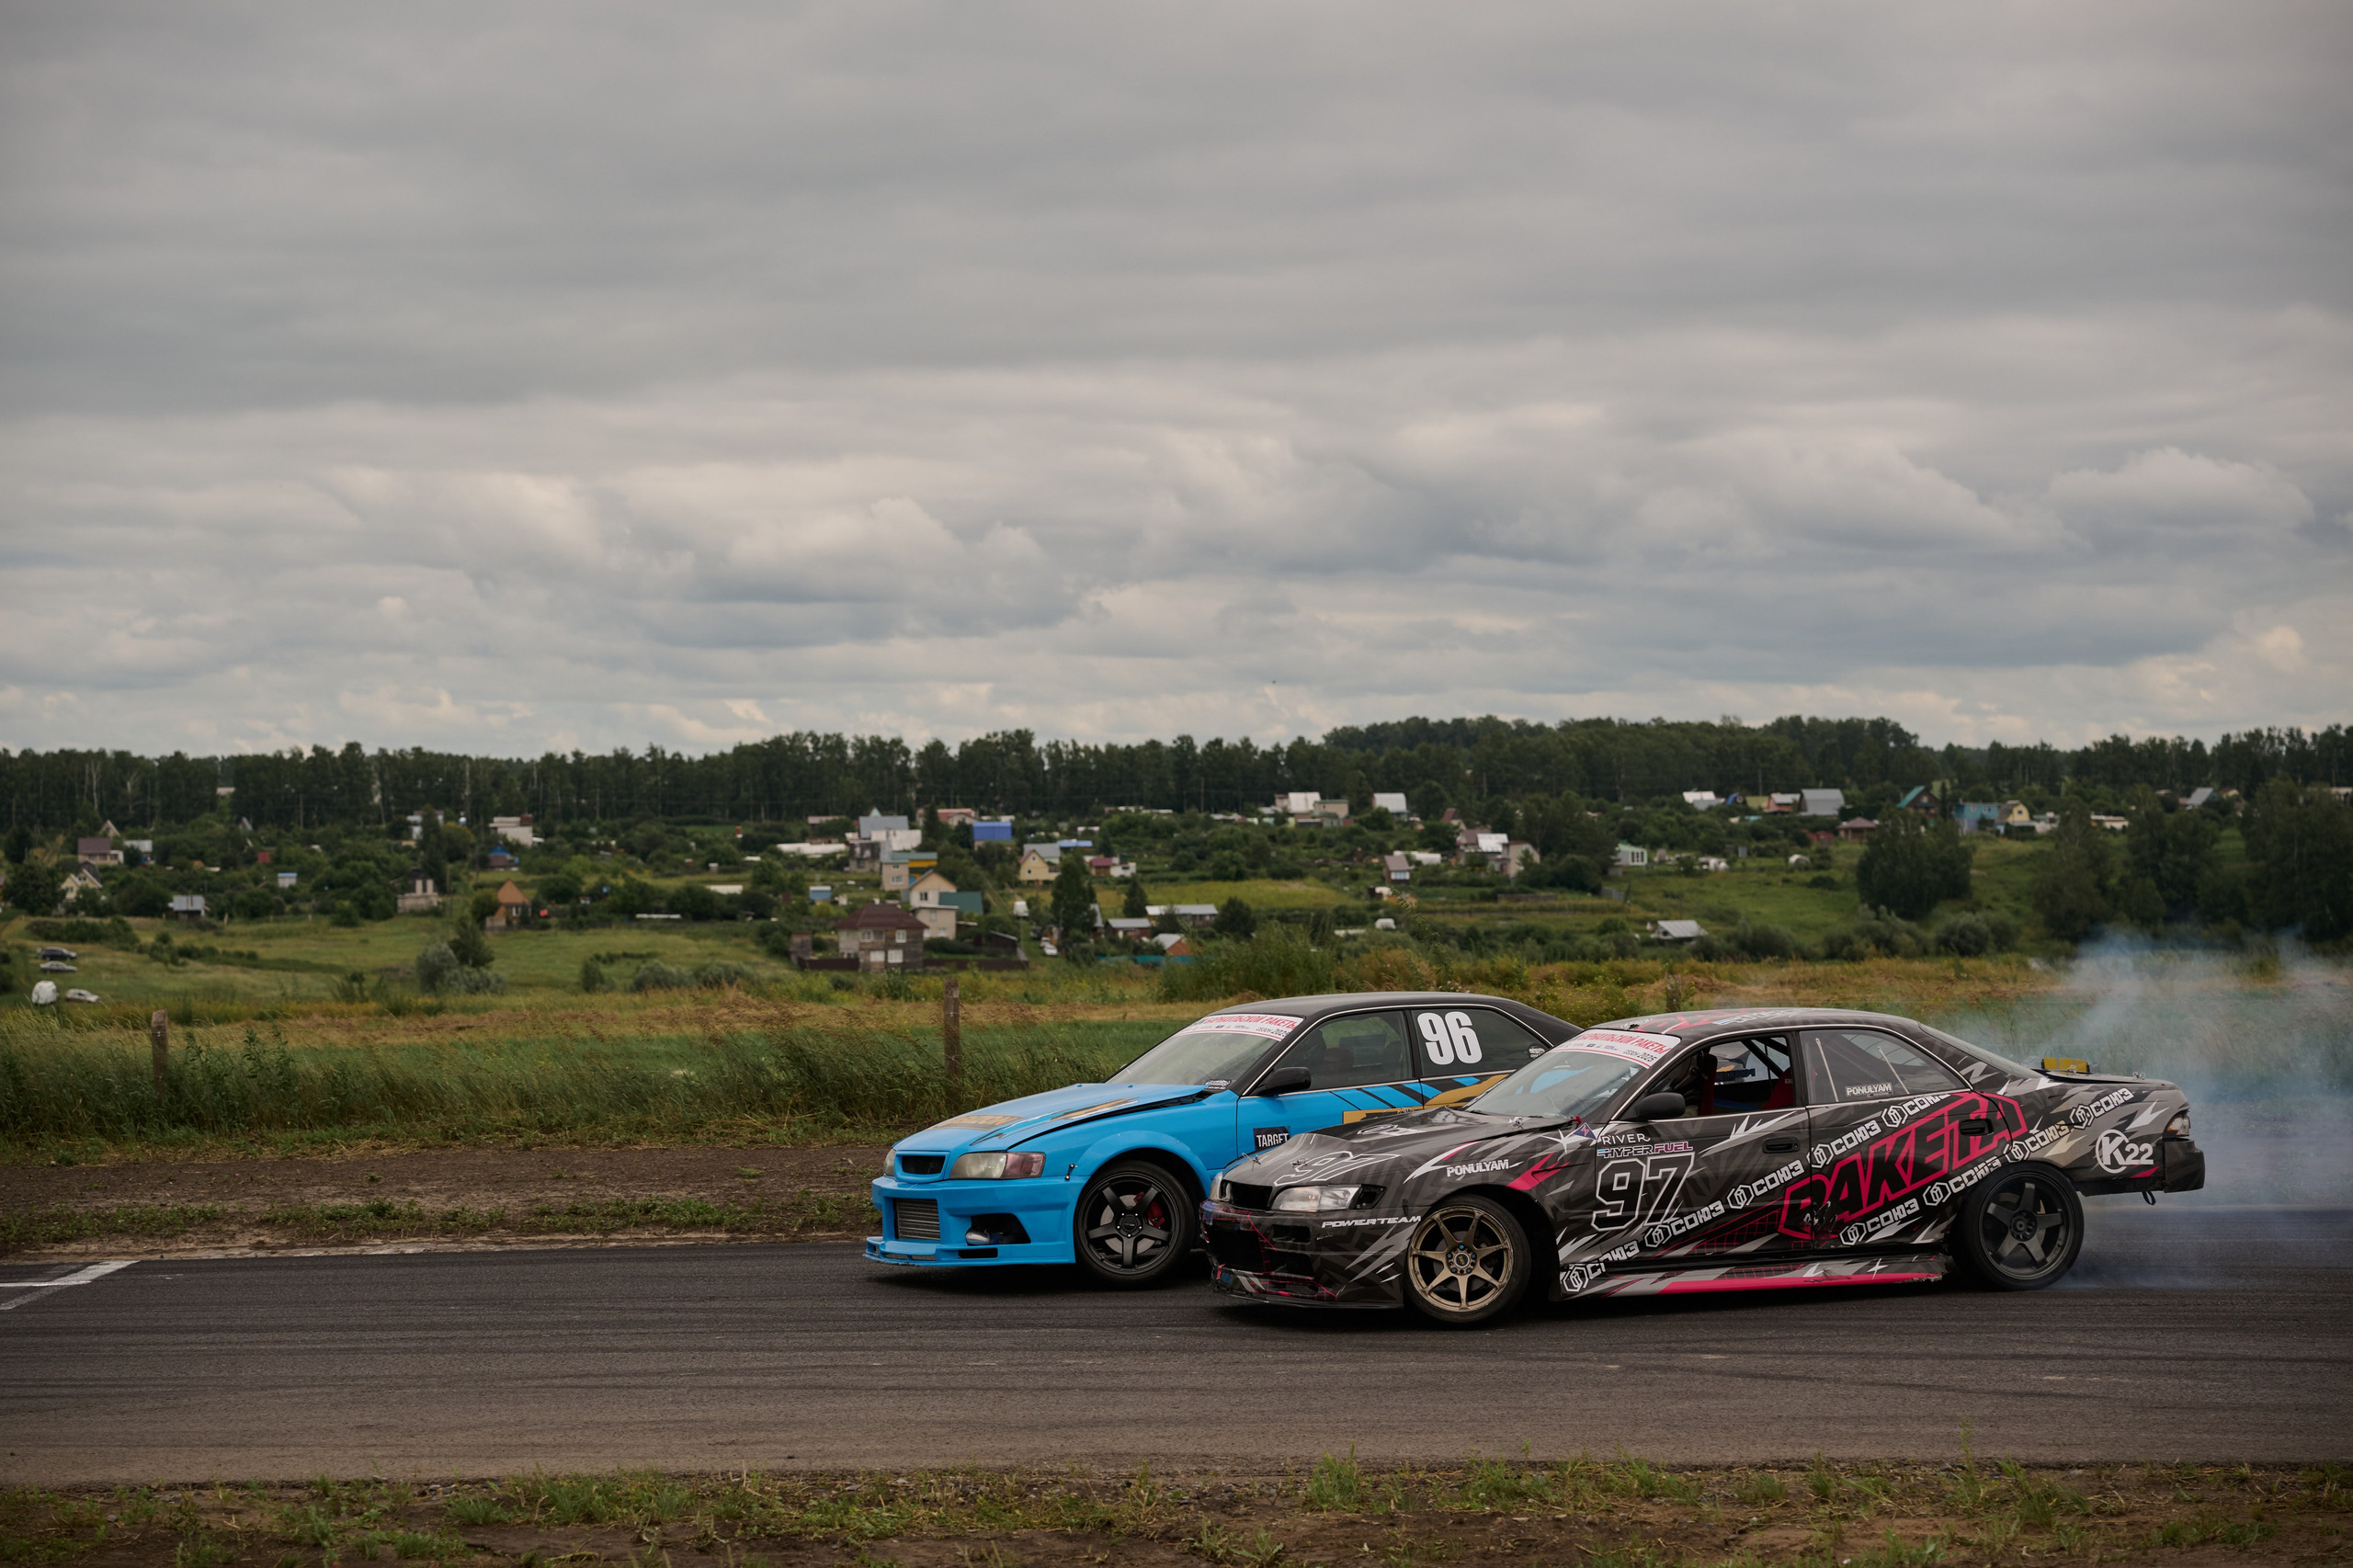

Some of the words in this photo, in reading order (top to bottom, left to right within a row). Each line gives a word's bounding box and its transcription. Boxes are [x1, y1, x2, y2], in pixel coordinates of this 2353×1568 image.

[1416, 1011, 1483, 1065] 96
[1631, 1038, 1671, 1054] РАКЕТЫ
[1637, 1052, 1657, 1062] 2025
[1847, 1083, 1892, 1096] PONULYAM
[2091, 1087, 2135, 1118] СОЮЗ
[1601, 1133, 1651, 1145] RIVER
[1831, 1119, 1882, 1155] СОЮЗ
[1274, 1151, 1402, 1187] 97
[1446, 1158, 1509, 1177] PONULYAM
[1751, 1160, 1804, 1197] СОЮЗ
[1591, 1152, 1695, 1232] 97
[1670, 1200, 1725, 1236] СОЮЗ
[1866, 1199, 1920, 1233] СОЮЗ
